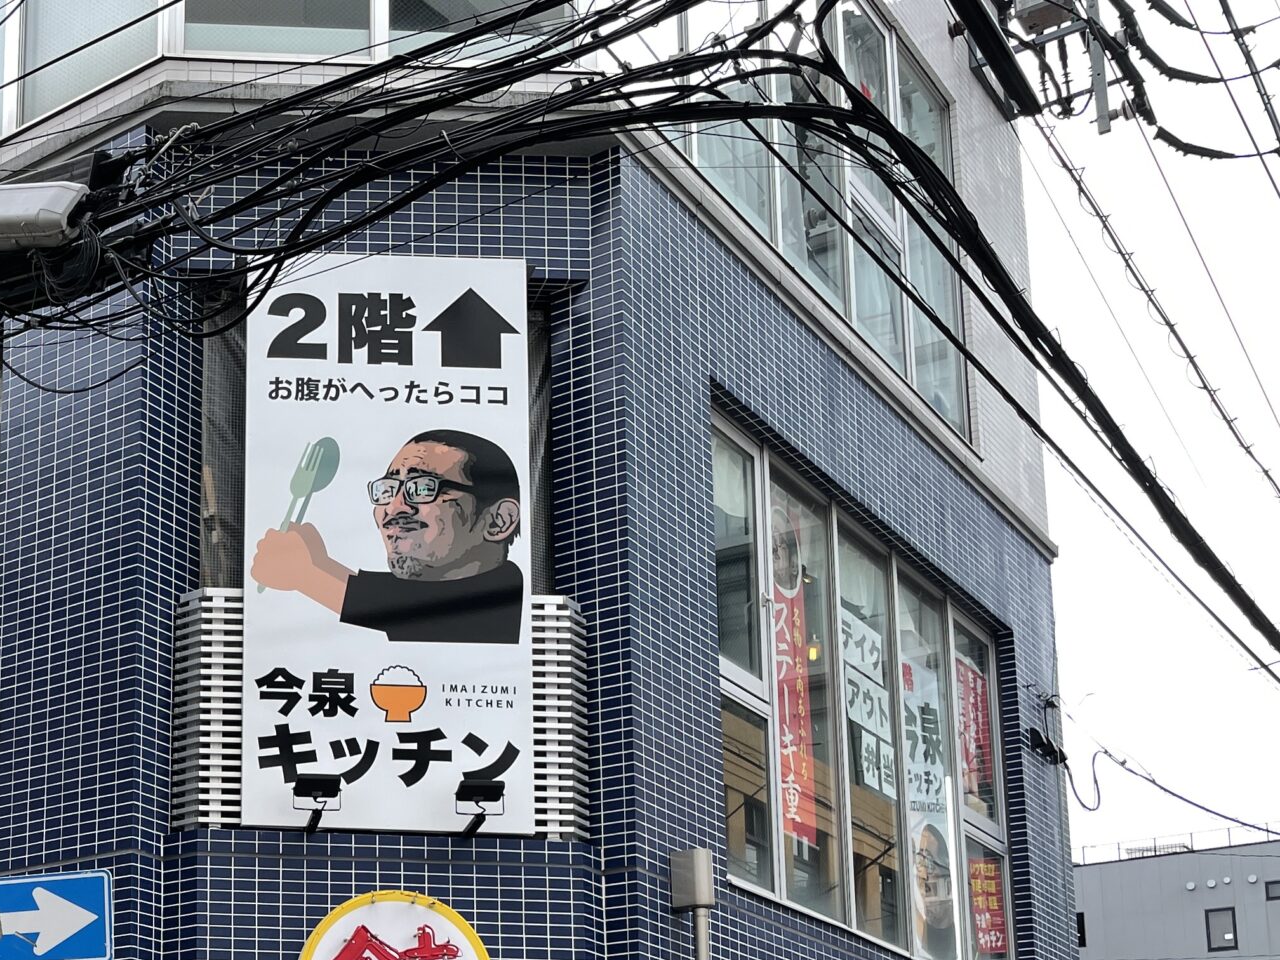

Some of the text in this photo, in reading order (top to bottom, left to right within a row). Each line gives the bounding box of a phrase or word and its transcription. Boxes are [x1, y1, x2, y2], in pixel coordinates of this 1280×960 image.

[266, 292, 417, 366] 2階
[268, 376, 508, 406] お腹がへったらココ
[255, 667, 359, 718] 今泉
[441, 684, 517, 695] IMAIZUMI
[445, 698, 515, 709] KITCHEN
[847, 678, 888, 728] アウト
[257, 723, 520, 788] キッチン
[863, 742, 895, 790] 弁当
